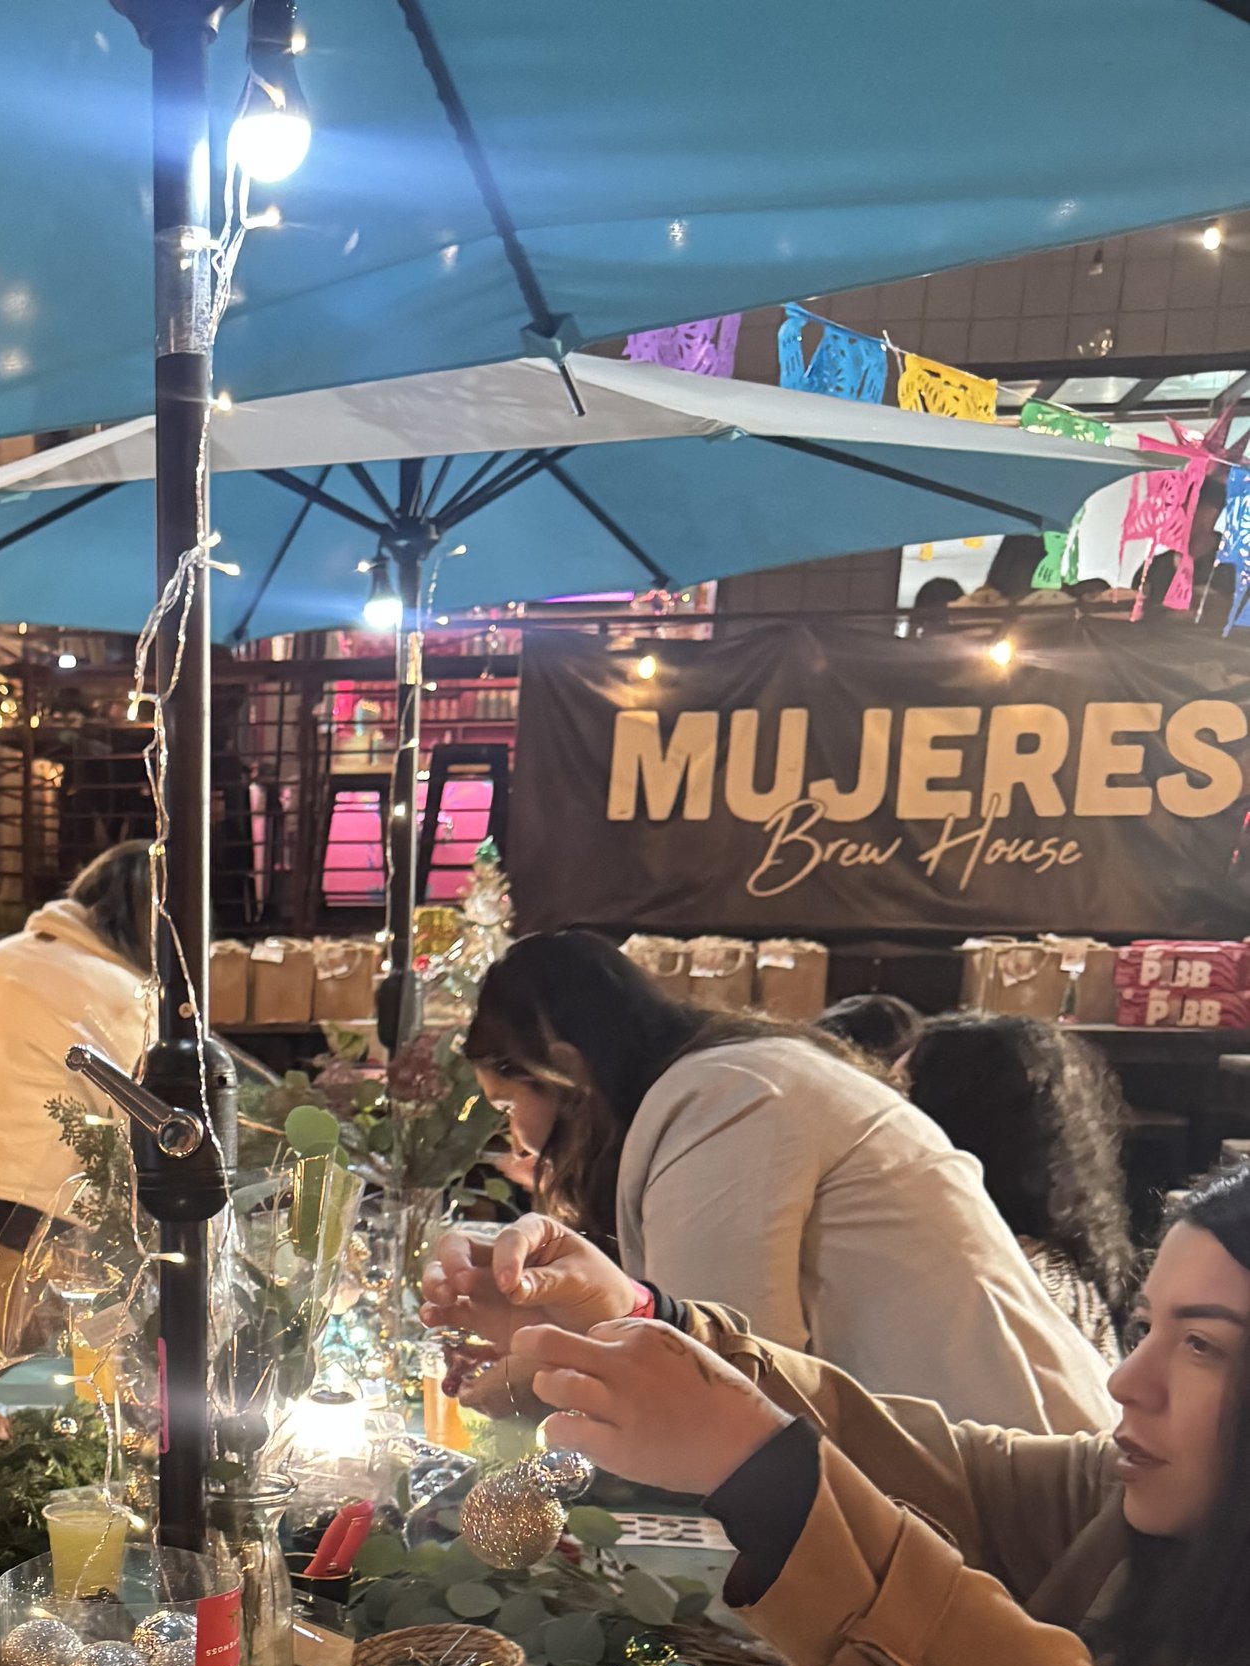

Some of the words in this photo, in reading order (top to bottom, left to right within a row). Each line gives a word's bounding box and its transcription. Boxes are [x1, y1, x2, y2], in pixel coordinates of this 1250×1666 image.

[607, 699, 1248, 822] MUJERES
[746, 798, 902, 897] Brew
[919, 793, 1084, 891] House
